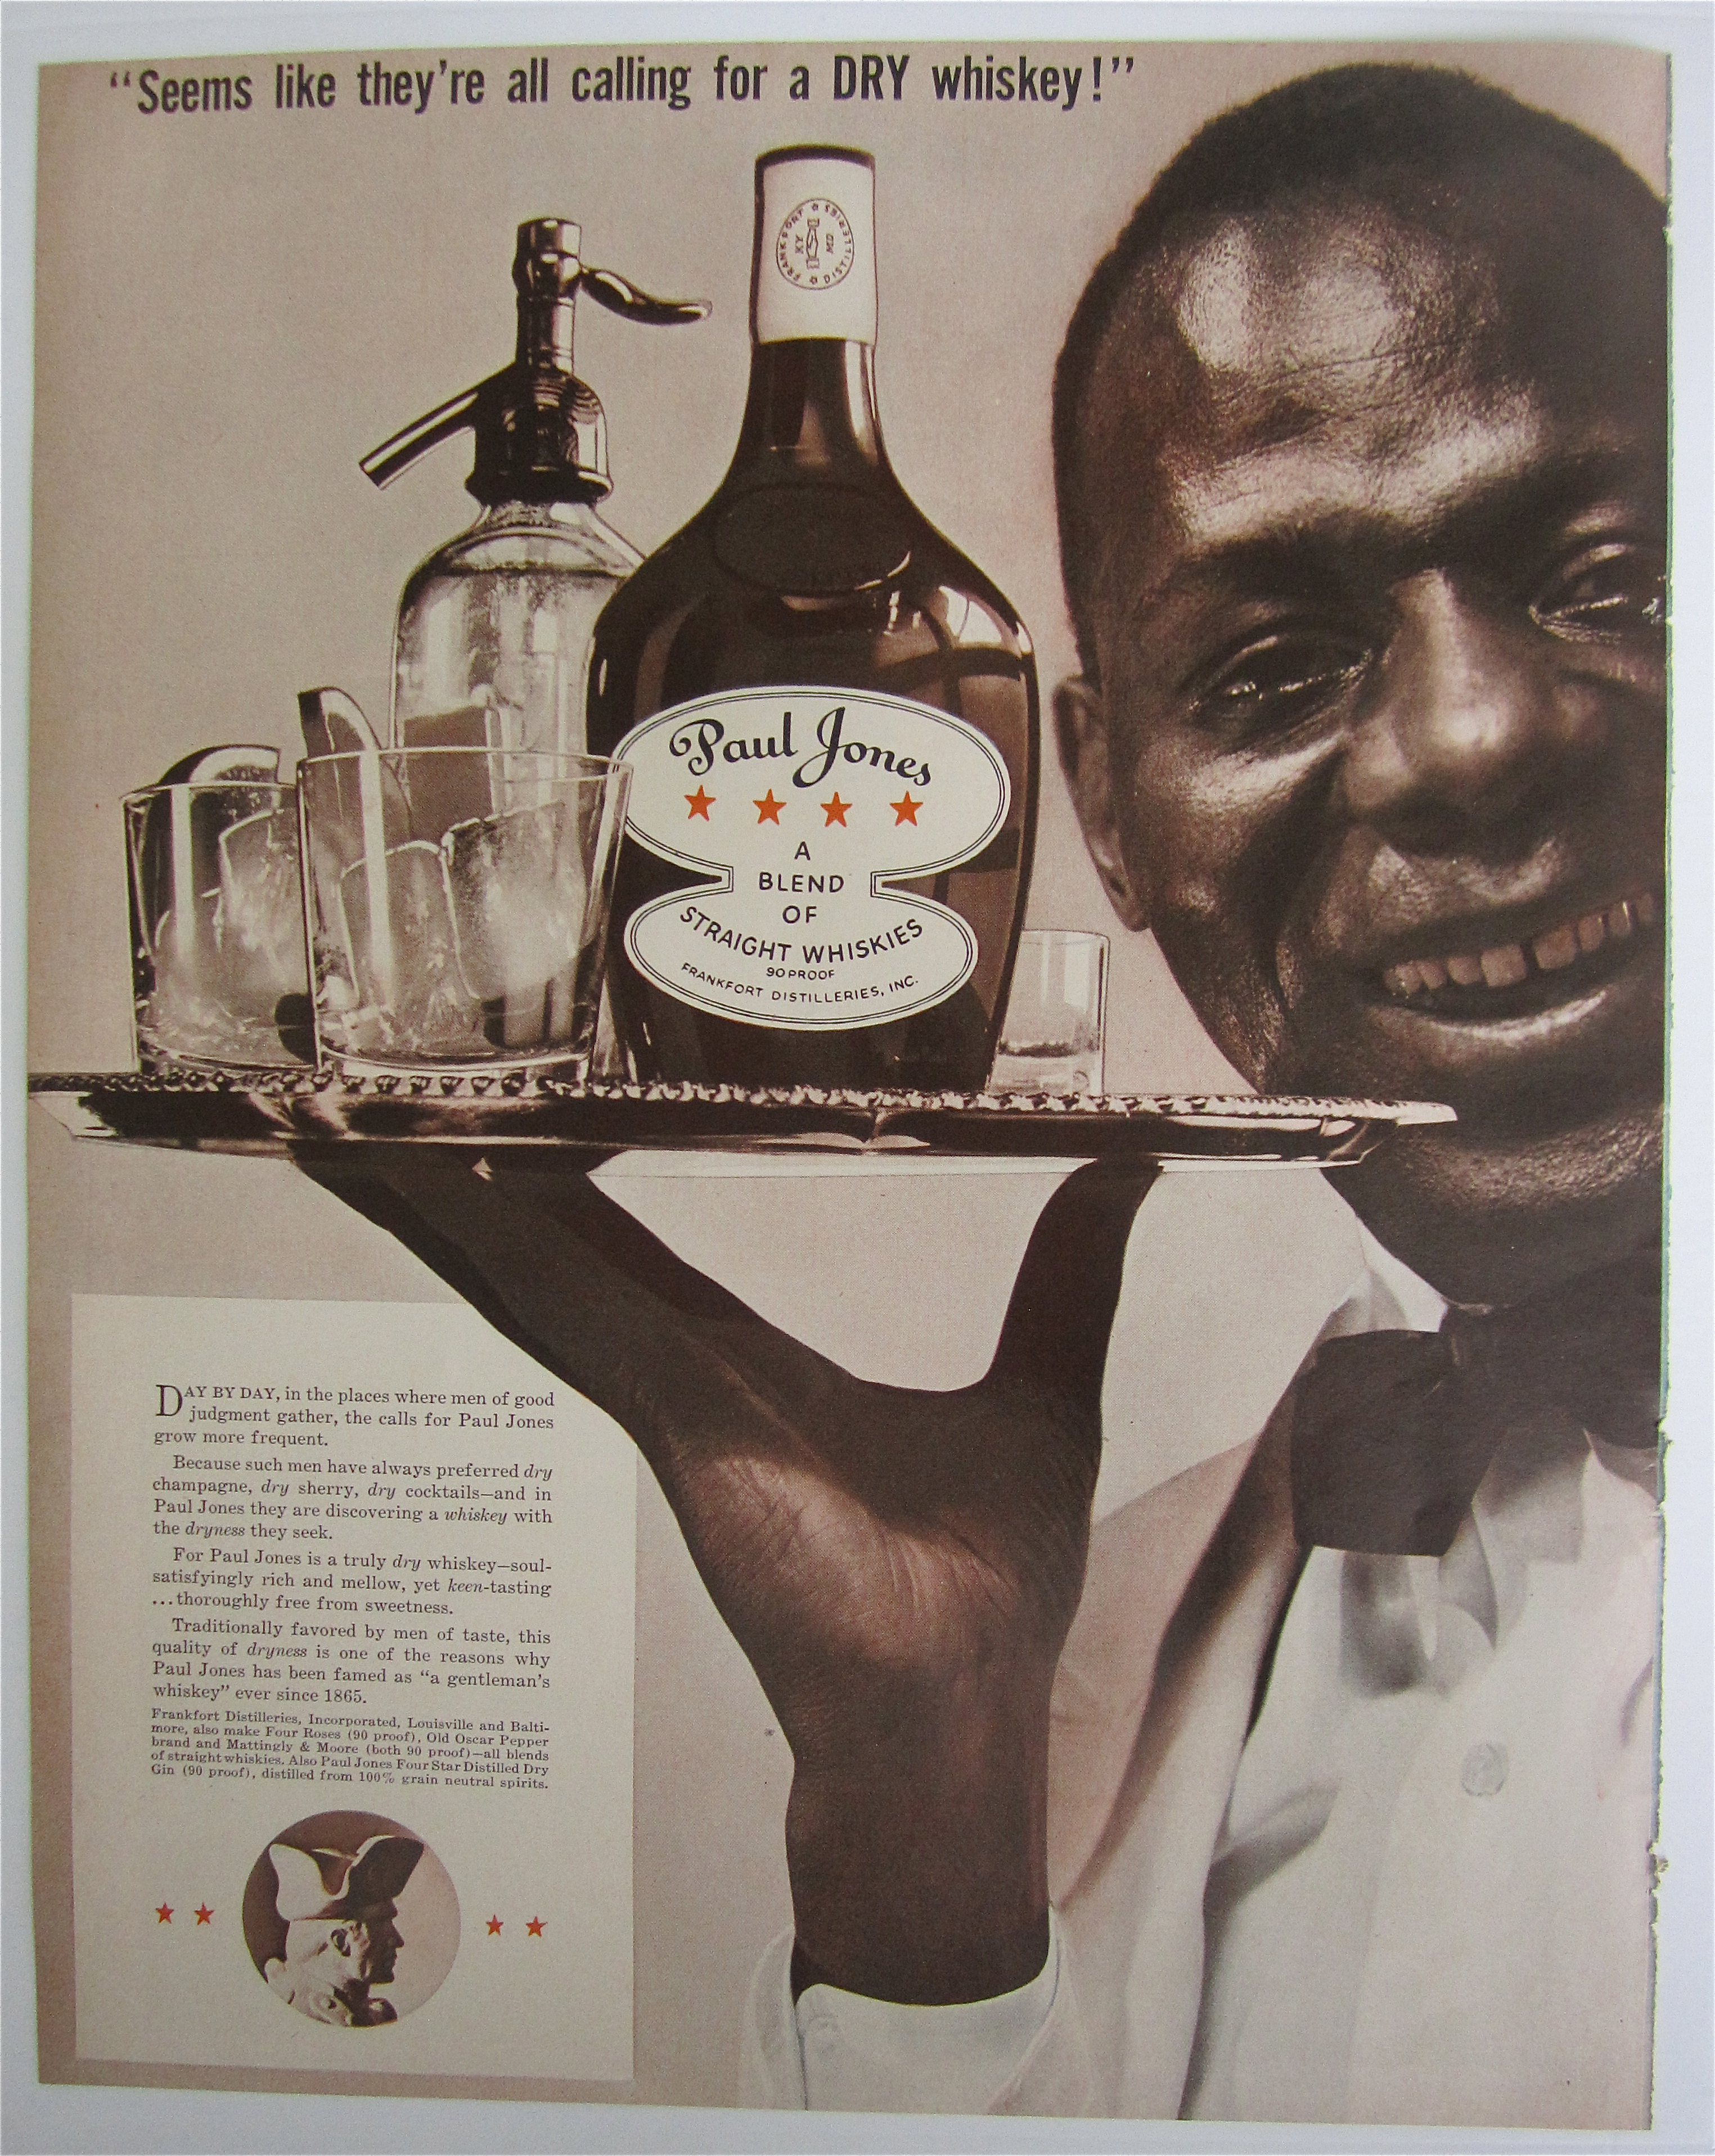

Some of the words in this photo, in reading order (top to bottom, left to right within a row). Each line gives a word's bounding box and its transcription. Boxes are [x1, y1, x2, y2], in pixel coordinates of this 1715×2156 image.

[110, 69, 253, 115] “Seems
[276, 62, 336, 109] like
[357, 59, 485, 115] they’re
[507, 57, 548, 103] all
[571, 56, 691, 111] calling
[713, 55, 768, 101] for
[789, 66, 809, 100] a
[834, 54, 910, 100] DRY
[931, 55, 1134, 111] whiskey!”
[668, 711, 798, 776] Paul
[792, 706, 931, 789] Jones
[794, 841, 811, 861] A
[759, 871, 844, 893] BLEND
[782, 905, 817, 924] OF
[679, 905, 793, 962] STRAIGHT
[802, 915, 922, 964] WHISKIES
[681, 962, 764, 1000] FRANKFORT
[772, 986, 884, 1003] DISTILLERIES,
[888, 974, 919, 993] INC.
[155, 1384, 208, 1417] DAY
[212, 1386, 236, 1399] BY
[240, 1387, 280, 1403] DAY,
[285, 1386, 301, 1401] in
[306, 1386, 333, 1401] the
[337, 1387, 390, 1405] places
[394, 1388, 447, 1404] where
[451, 1394, 487, 1405] men
[492, 1391, 510, 1406] of
[514, 1391, 555, 1409] good
[188, 1405, 271, 1424] judgment
[276, 1408, 338, 1427] gather,
[344, 1409, 372, 1425] the
[378, 1411, 417, 1426] calls
[424, 1411, 451, 1427] for
[458, 1412, 499, 1428] Paul
[505, 1413, 554, 1429] Jones
[154, 1432, 197, 1446] grow
[202, 1433, 245, 1444] more
[250, 1429, 328, 1448] frequent.
[172, 1454, 241, 1471] Because
[245, 1457, 283, 1472] such
[287, 1462, 322, 1473] men
[327, 1458, 367, 1474] have
[371, 1460, 431, 1479] always
[436, 1462, 520, 1480] preferred
[524, 1463, 553, 1482] dry
[152, 1476, 253, 1496] champagne,
[260, 1478, 290, 1497] dry
[298, 1480, 359, 1499] sherry,
[367, 1482, 396, 1500] dry
[534, 1486, 552, 1501] in
[153, 1498, 193, 1514] Paul
[197, 1499, 245, 1515] Jones
[250, 1501, 287, 1519] they
[292, 1506, 320, 1517] are
[325, 1503, 424, 1523] discovering
[429, 1510, 439, 1521] a
[444, 1507, 508, 1526] whiskey
[513, 1508, 553, 1523] with
[152, 1519, 180, 1535] the
[184, 1521, 245, 1539] dryness
[250, 1522, 287, 1541] they
[292, 1524, 333, 1540] seek.
[173, 1546, 204, 1562] For
[209, 1548, 249, 1563] Paul
[254, 1549, 301, 1565] Jones
[307, 1551, 321, 1566] is
[327, 1555, 337, 1566] a
[343, 1553, 387, 1571] truly
[392, 1554, 421, 1572] dry
[152, 1568, 254, 1589] satisfyingly
[262, 1572, 295, 1587] rich
[303, 1573, 334, 1589] and
[341, 1575, 406, 1594] mellow,
[413, 1578, 440, 1594] yet
[447, 1577, 552, 1598] keen-tasting
[275, 1594, 310, 1609] free
[316, 1595, 358, 1612] from
[365, 1599, 453, 1615] sweetness.
[172, 1617, 283, 1638] Traditionally
[290, 1621, 356, 1638] favored
[364, 1623, 385, 1641] by
[393, 1629, 428, 1640] men
[437, 1627, 454, 1641] of
[462, 1628, 510, 1645] taste,
[518, 1629, 551, 1644] this
[152, 1639, 212, 1658] quality
[220, 1641, 238, 1656] of
[246, 1641, 308, 1660] dryness
[316, 1644, 330, 1659] is
[339, 1649, 368, 1660] one
[377, 1647, 395, 1661] of
[403, 1647, 431, 1662] the
[440, 1653, 505, 1665] reasons
[514, 1651, 551, 1669] why
[152, 1660, 191, 1676] Paul
[198, 1662, 245, 1678] Jones
[252, 1663, 281, 1679] has
[288, 1665, 326, 1680] been
[333, 1667, 386, 1682] famed
[394, 1673, 412, 1684] as
[235, 1689, 271, 1701] ever
[276, 1686, 319, 1702] since
[325, 1689, 367, 1704] 1865.
[151, 1707, 220, 1722] Frankfort
[225, 1710, 301, 1725] Distilleries,
[308, 1713, 400, 1729] Incorporated,
[407, 1717, 474, 1730] Louisville
[479, 1720, 505, 1731] and
[510, 1721, 550, 1733] Balti-
[151, 1725, 188, 1735] more,
[193, 1724, 219, 1735] also
[224, 1725, 260, 1736] make
[265, 1726, 299, 1738] Four
[303, 1727, 341, 1739] Roses
[348, 1729, 368, 1741] (90
[373, 1731, 421, 1744] proof),
[426, 1731, 449, 1744] Old
[454, 1733, 495, 1745] Oscar
[499, 1734, 549, 1748] Pepper
[151, 1735, 190, 1748] brand
[196, 1738, 220, 1749] and
[226, 1738, 293, 1753] Mattingly
[299, 1741, 310, 1752] &
[316, 1741, 358, 1754] Moore
[366, 1744, 401, 1756] (both
[407, 1745, 422, 1756] 90
[506, 1748, 550, 1761] blends
[150, 1750, 165, 1761] of
[168, 1751, 222, 1763] straight
[224, 1753, 285, 1765] whiskies.
[289, 1754, 317, 1766] Also
[321, 1756, 351, 1767] Paul
[354, 1757, 393, 1769] Jones
[396, 1758, 429, 1770] Four
[431, 1760, 461, 1772] Star
[463, 1761, 519, 1774] Distilled
[523, 1763, 549, 1776] Dry
[151, 1763, 175, 1775] Gin
[182, 1765, 202, 1777] (90
[208, 1767, 256, 1780] proof),
[262, 1767, 314, 1780] distilled
[320, 1770, 353, 1781] from
[359, 1771, 395, 1784] 100%
[402, 1774, 438, 1785] grain
[444, 1776, 494, 1787] neutral
[500, 1776, 548, 1789] spirits.
